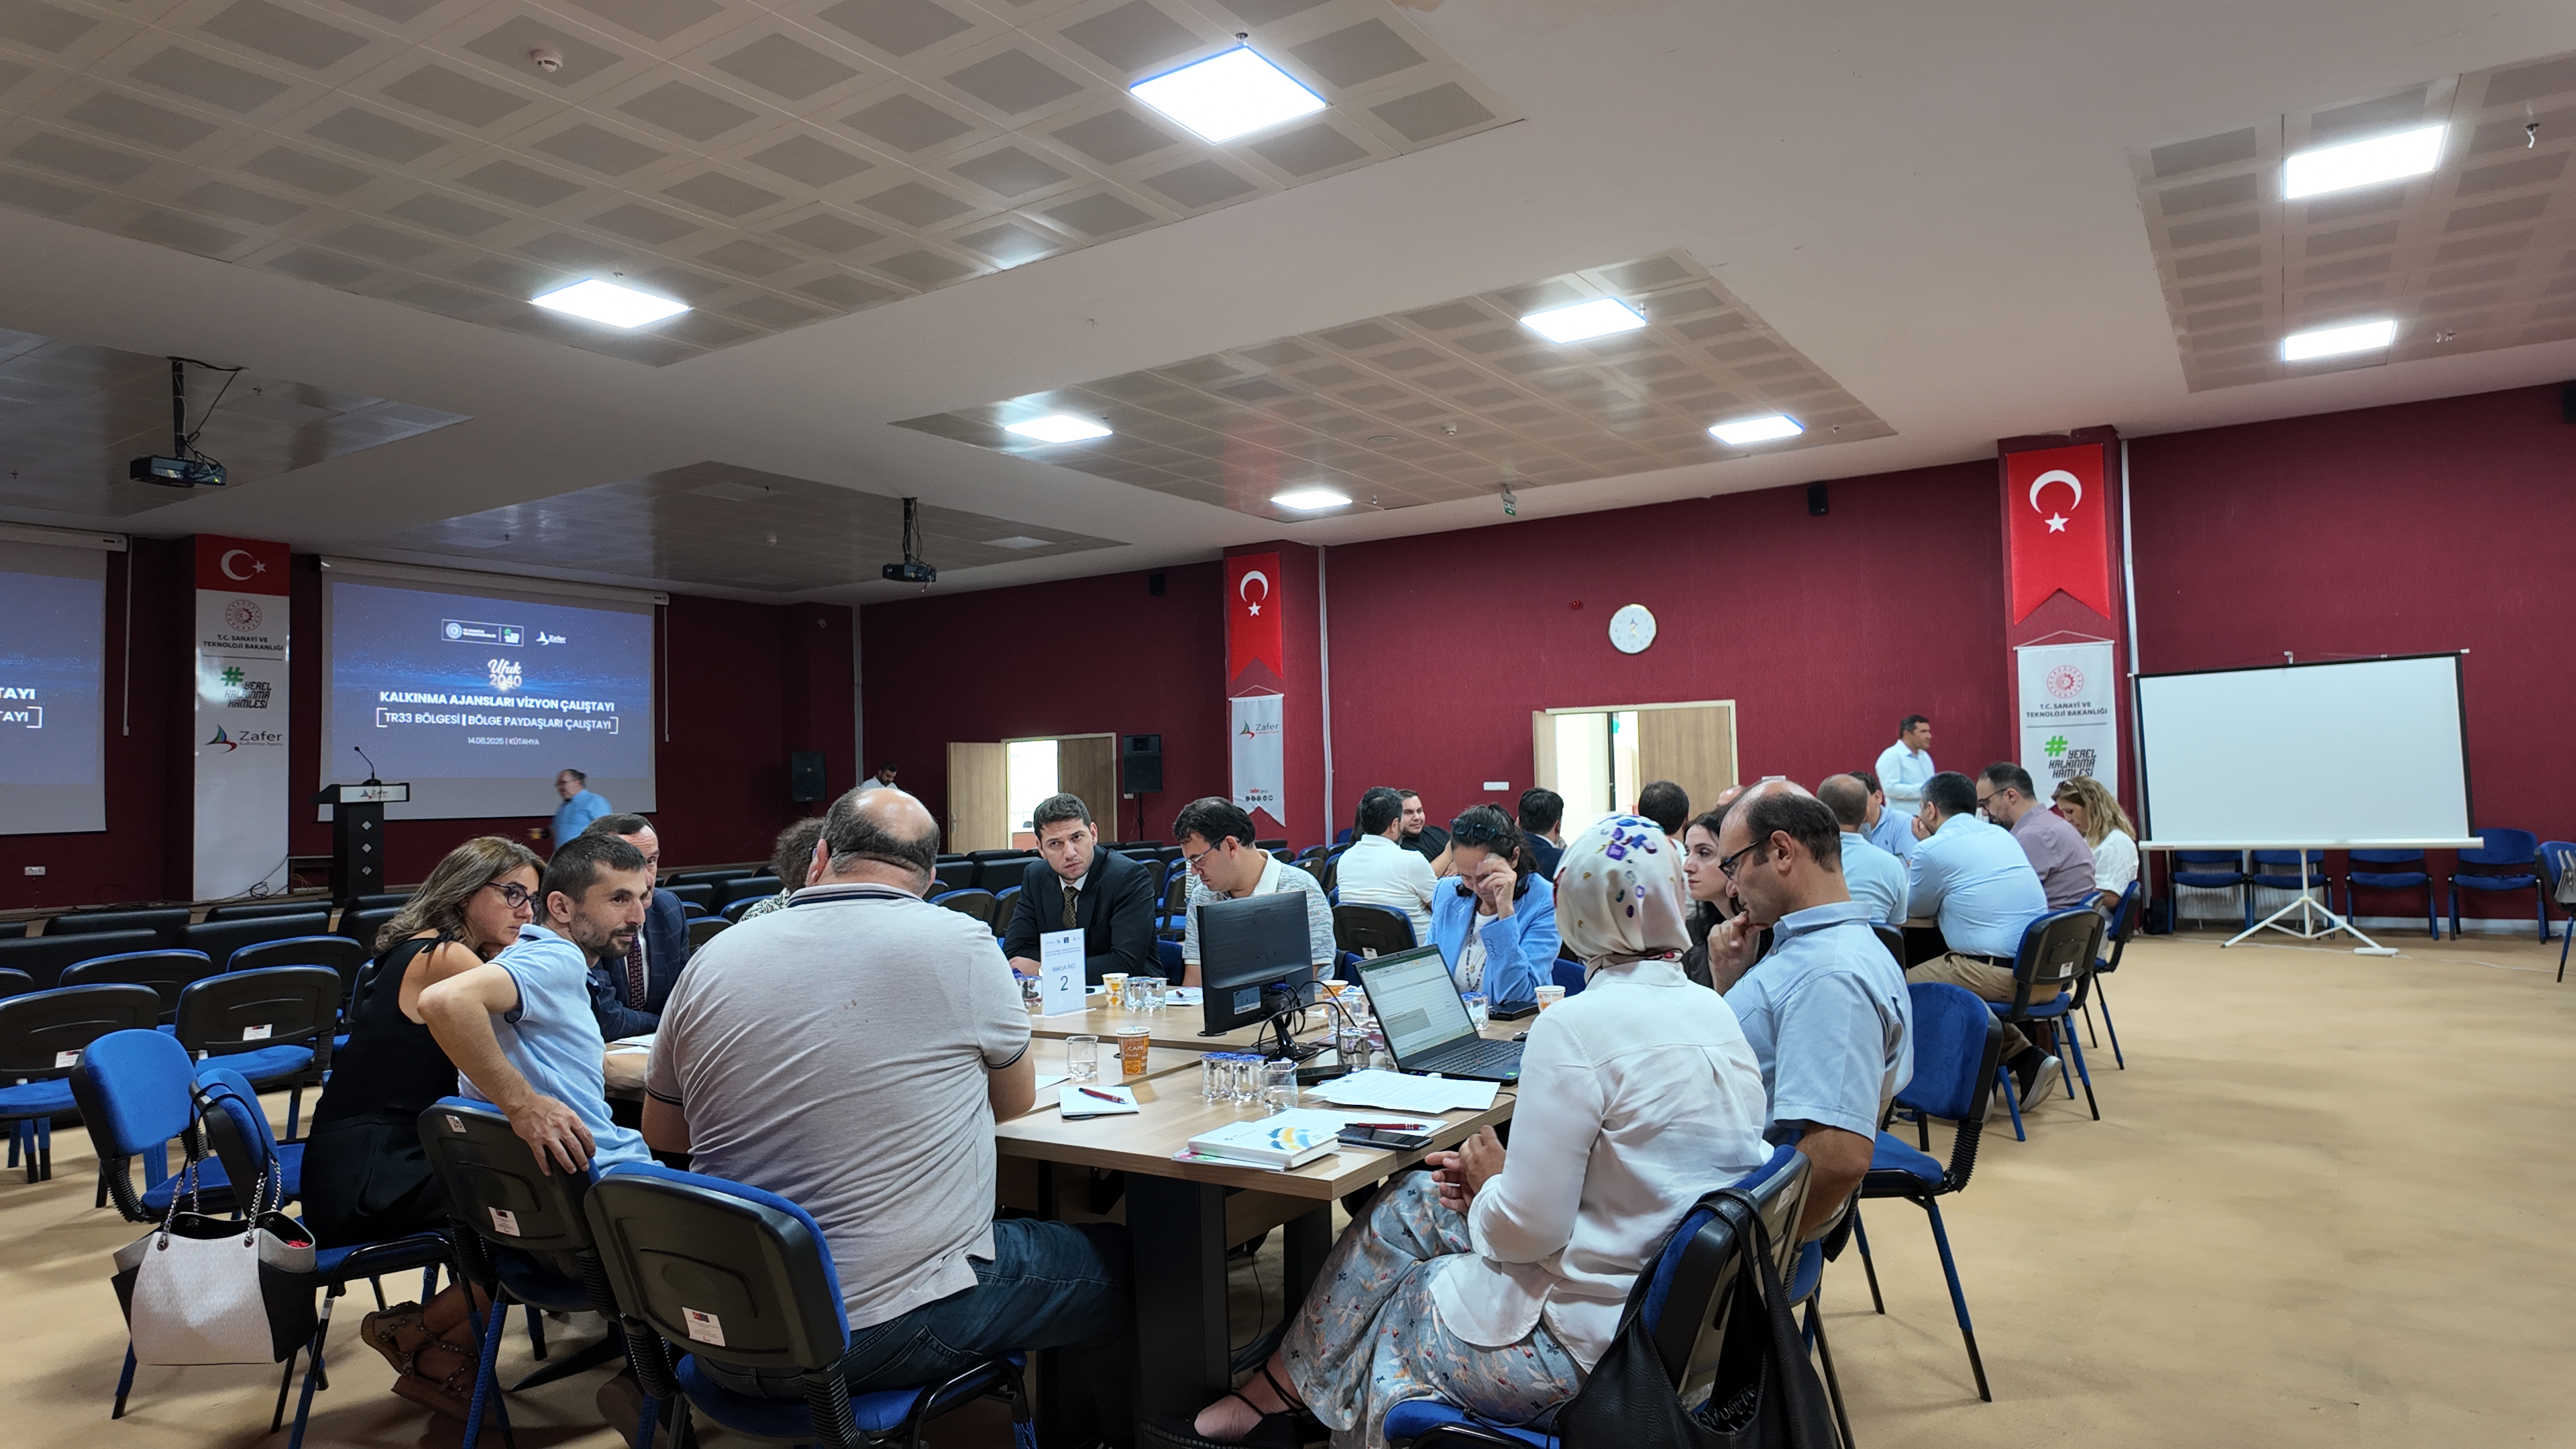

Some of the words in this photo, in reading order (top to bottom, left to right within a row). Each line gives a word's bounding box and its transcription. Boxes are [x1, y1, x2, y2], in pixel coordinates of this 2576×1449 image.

[231, 635, 258, 643] SANAYİ
[203, 641, 244, 649] TEKNOLOJİ
[488, 658, 522, 674] Ufuk
[244, 681, 272, 691] YEREL
[489, 674, 522, 688] 2040
[228, 699, 268, 708] HAMLESİ
[380, 691, 447, 704] KALKINMA
[449, 694, 514, 707] AJANSLARI
[517, 696, 559, 709] VİZYON
[560, 700, 614, 713] ÇALIŞTAYI
[2053, 702, 2080, 710] SANAYİ
[2027, 710, 2065, 718] TEKNOLOJİ
[2067, 708, 2108, 716] BAKANLIĞI
[384, 712, 413, 723] TR33
[415, 712, 460, 724] BÖLGESİ
[468, 714, 502, 726] BÖLGE
[504, 716, 563, 730] PAYDAŞLARI
[565, 719, 611, 731] ÇALIŞTAYI
[1255, 722, 1279, 731] Zafer
[239, 731, 283, 741] Zafer
[468, 737, 504, 745] 14.08.2025
[509, 737, 539, 745] KÜTAHYA
[2068, 749, 2096, 759] YEREL
[2048, 758, 2095, 769] KALKINMA
[1053, 964, 1067, 972] MASA
[1061, 975, 1068, 991] 2
